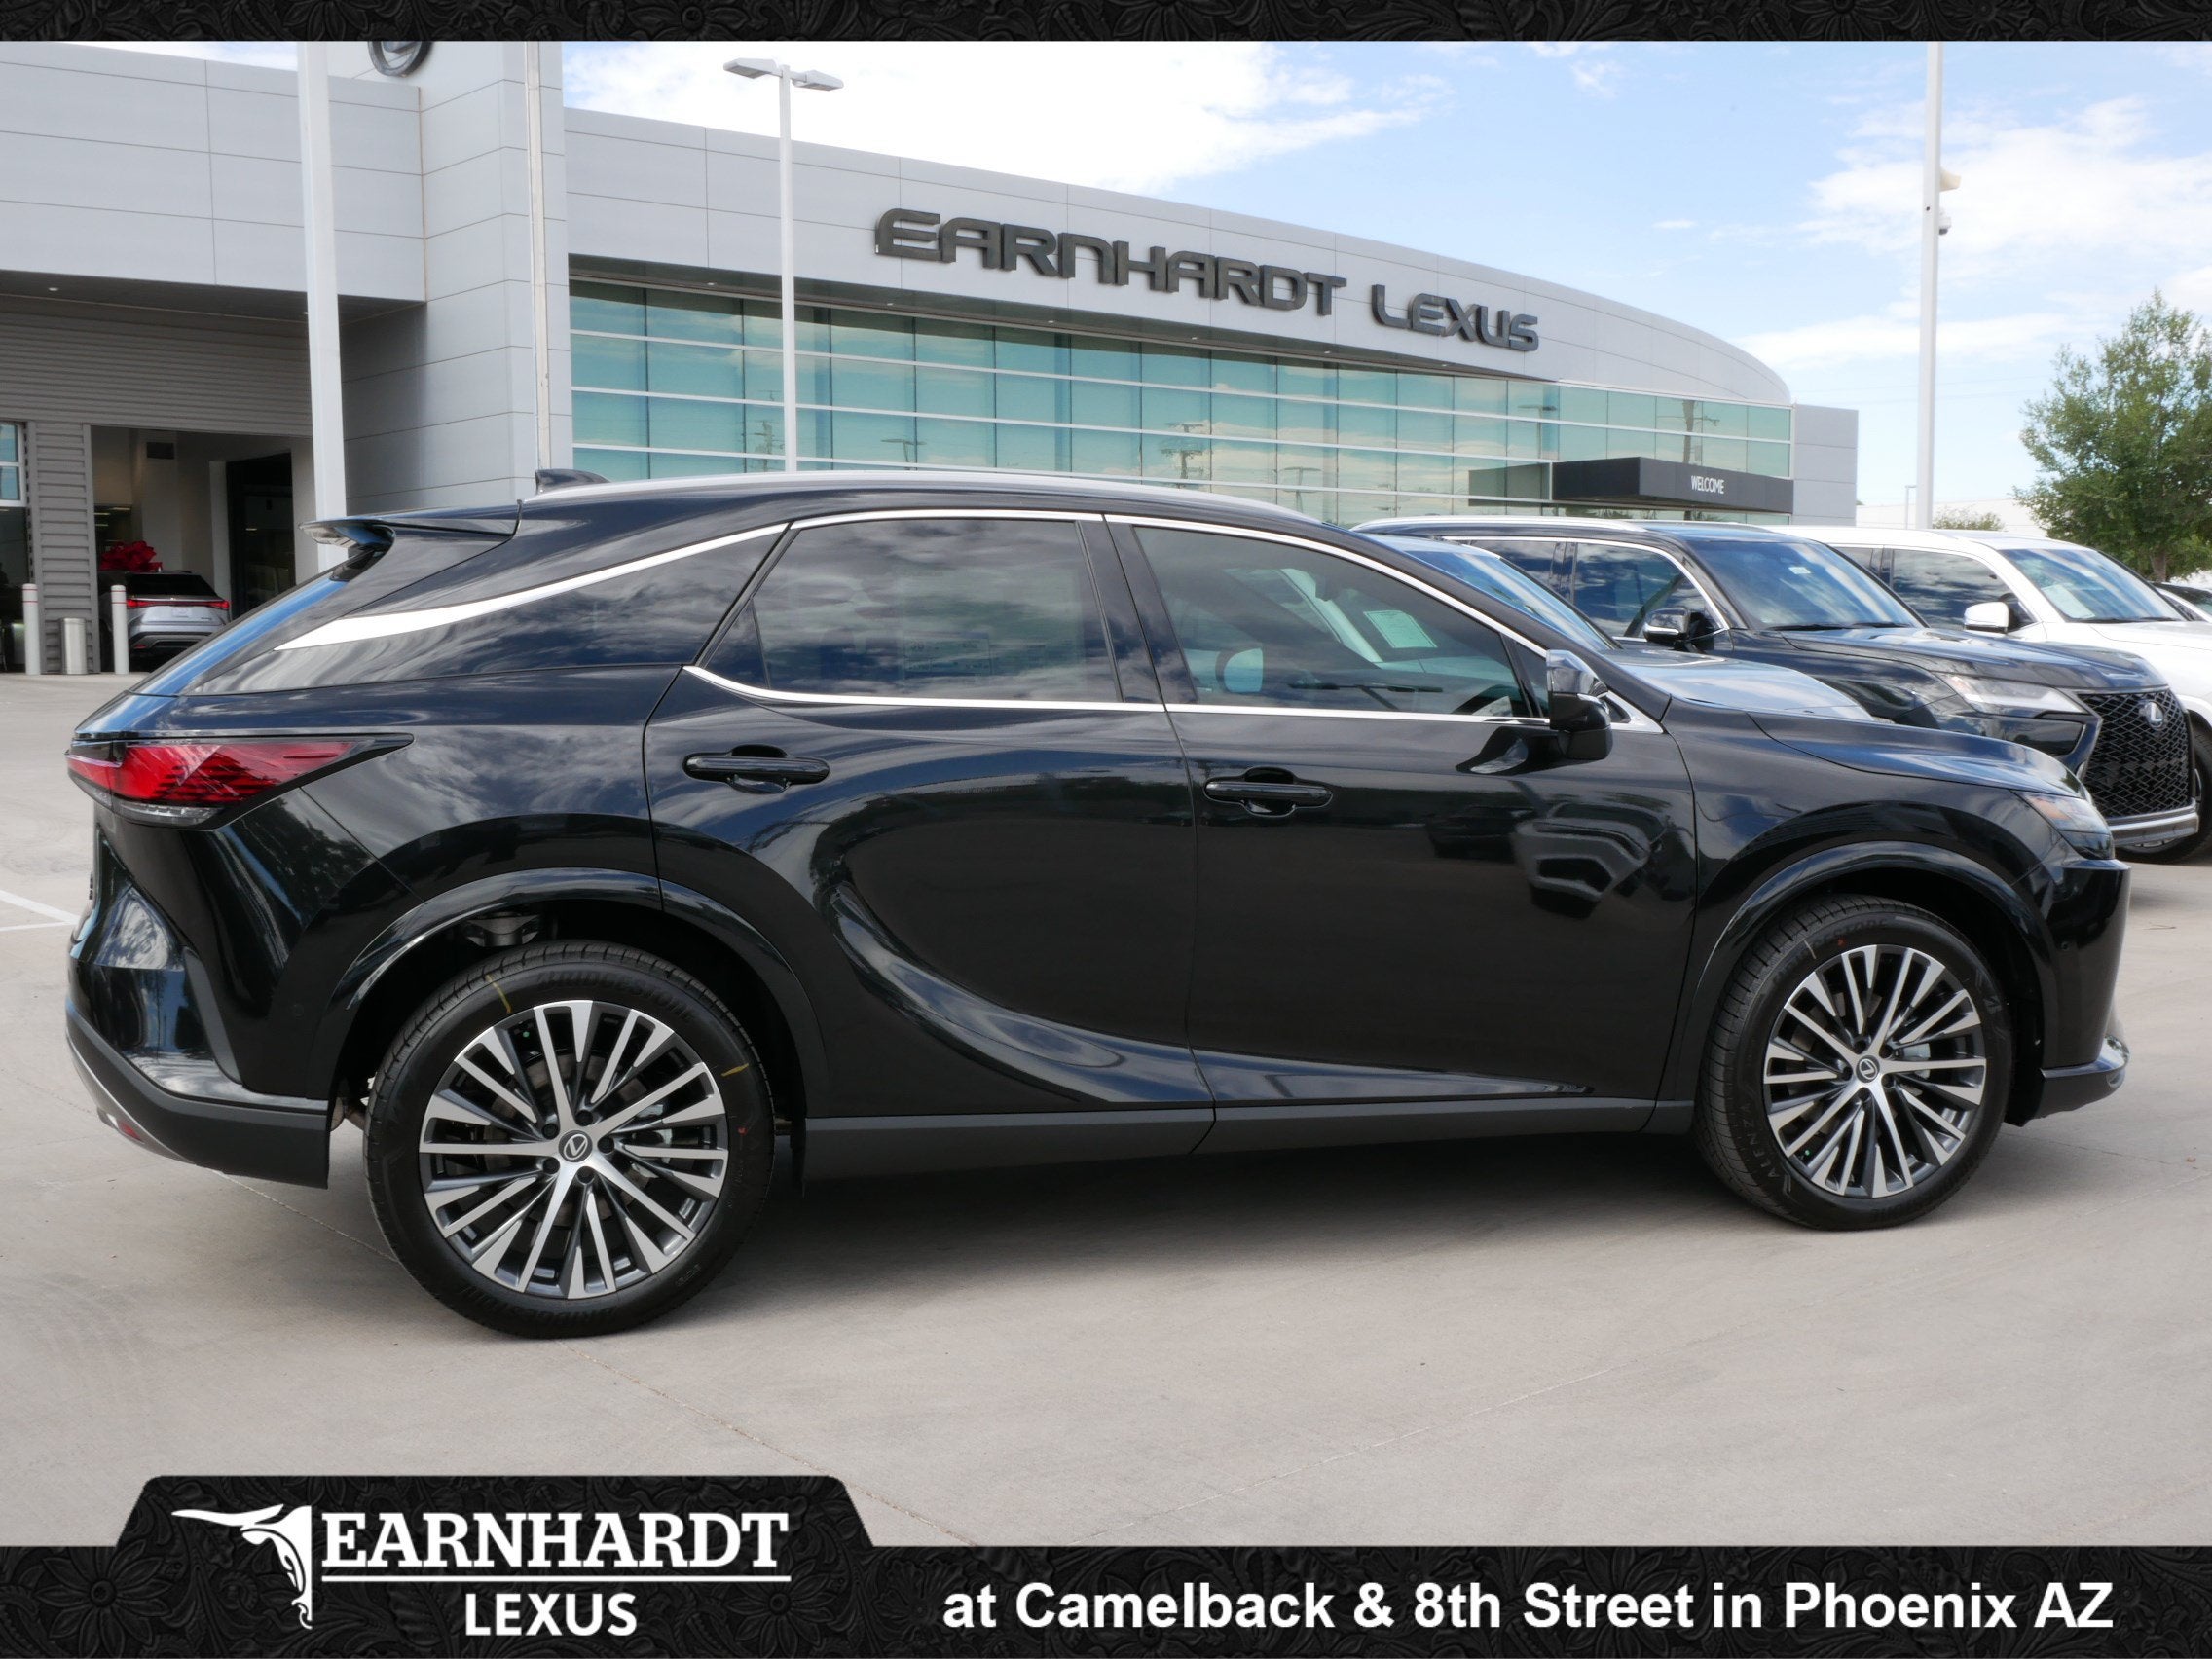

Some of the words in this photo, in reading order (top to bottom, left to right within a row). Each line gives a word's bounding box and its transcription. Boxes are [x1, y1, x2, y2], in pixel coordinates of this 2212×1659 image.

[876, 207, 1346, 316] EARNHARDT
[1372, 283, 1539, 351] LEXUS
[1690, 475, 1725, 495] WELCOME
